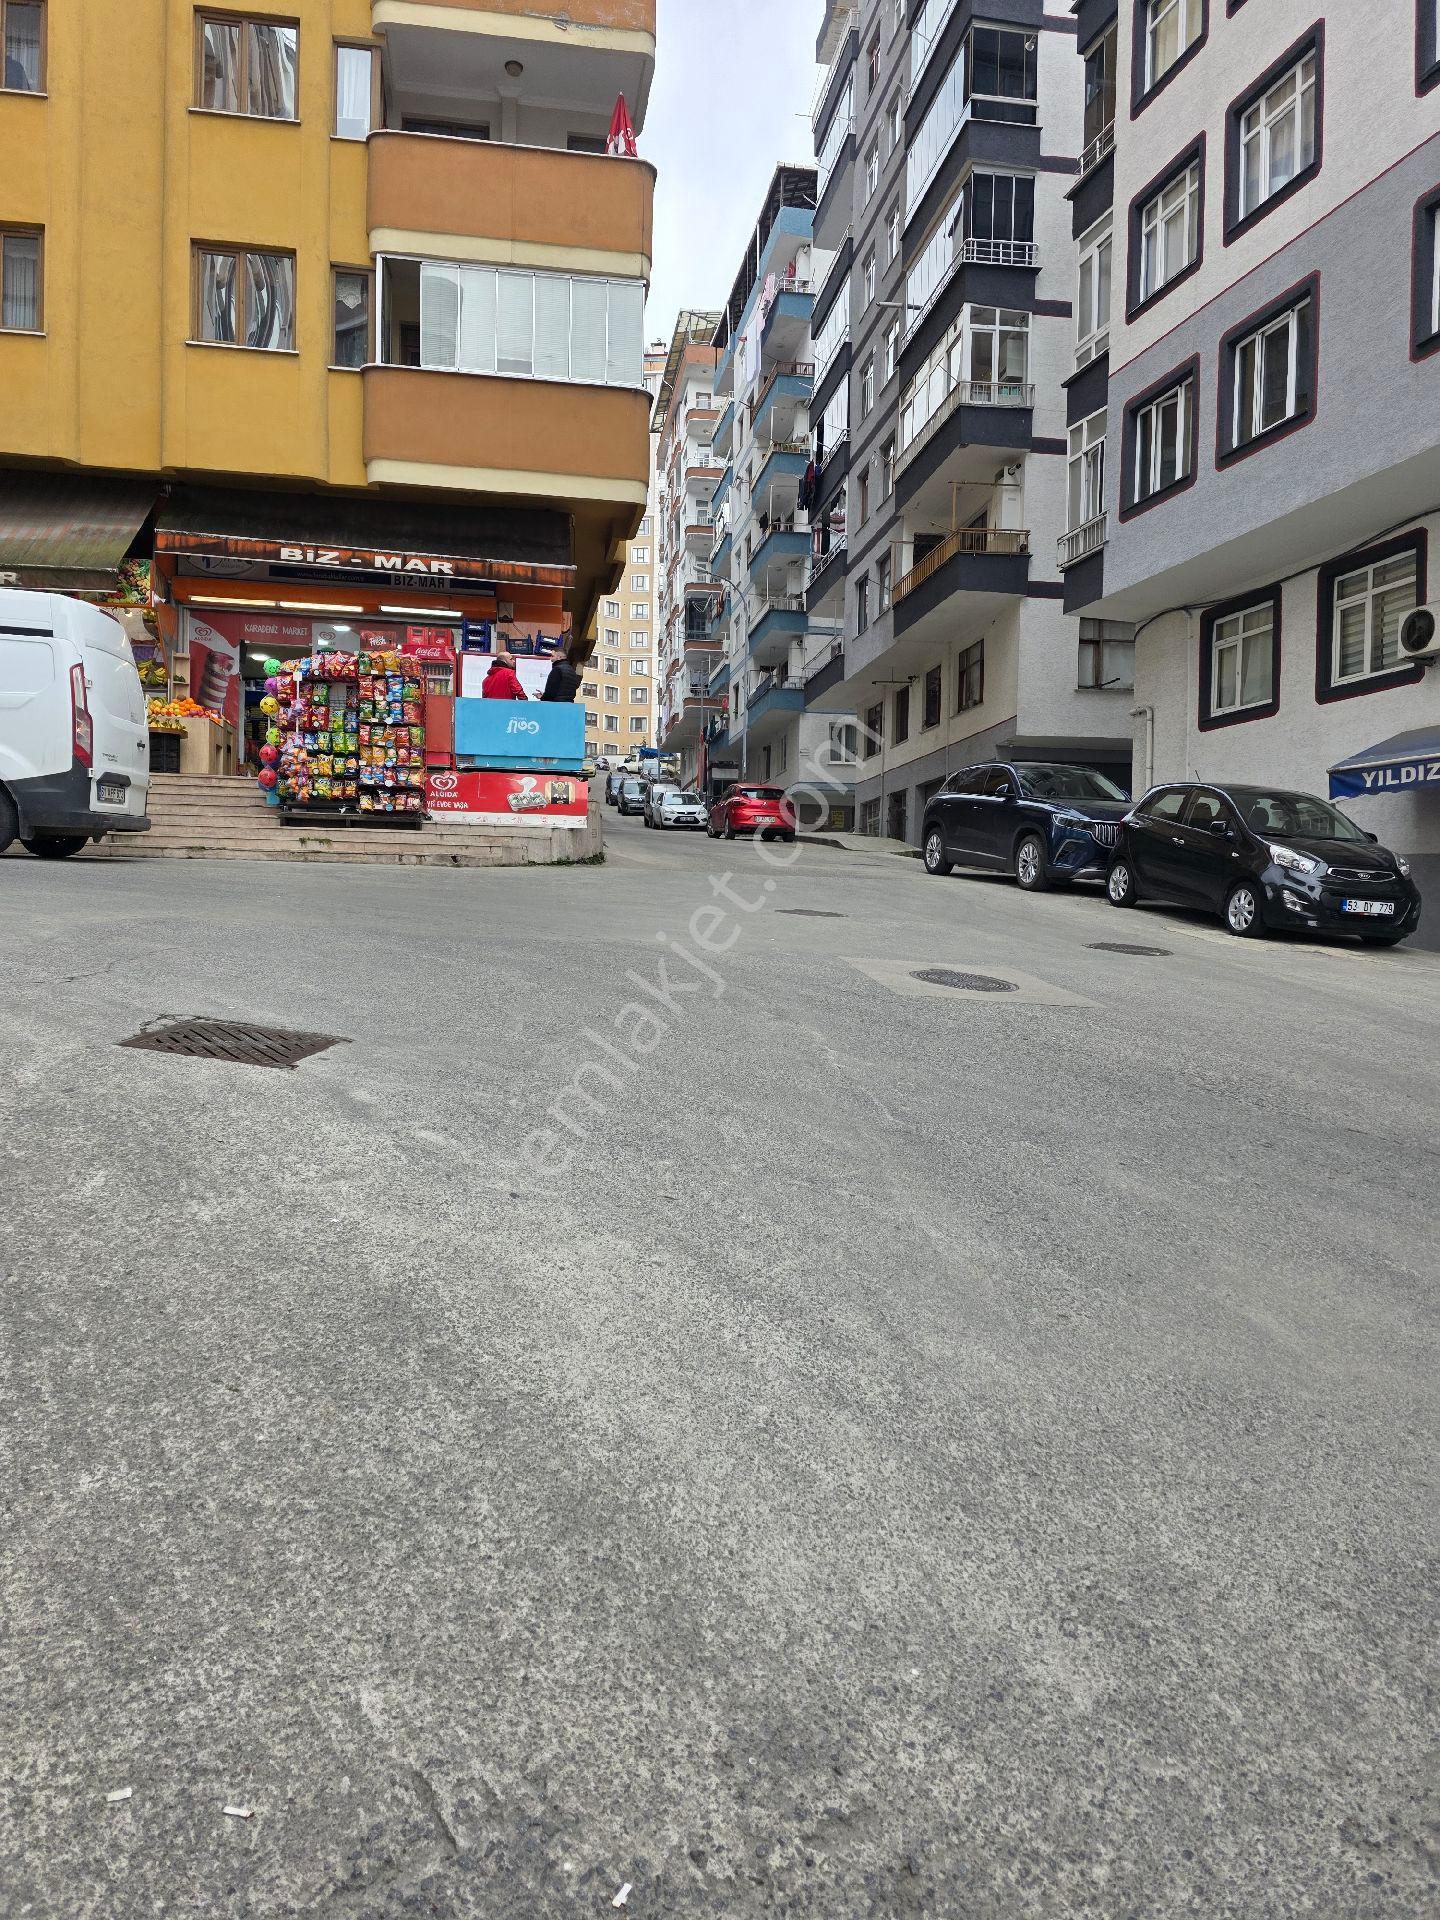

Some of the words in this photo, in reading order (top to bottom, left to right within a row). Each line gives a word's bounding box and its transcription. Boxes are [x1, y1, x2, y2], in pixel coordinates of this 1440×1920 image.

[374, 555, 454, 574] MAR
[282, 626, 308, 636] MARKET
[1361, 762, 1440, 788] YILDIZ
[430, 790, 458, 798] ALGIDA
[436, 800, 452, 808] EVDE
[1347, 900, 1358, 911] 53
[1363, 901, 1374, 913] DY
[1379, 903, 1393, 914] 779
